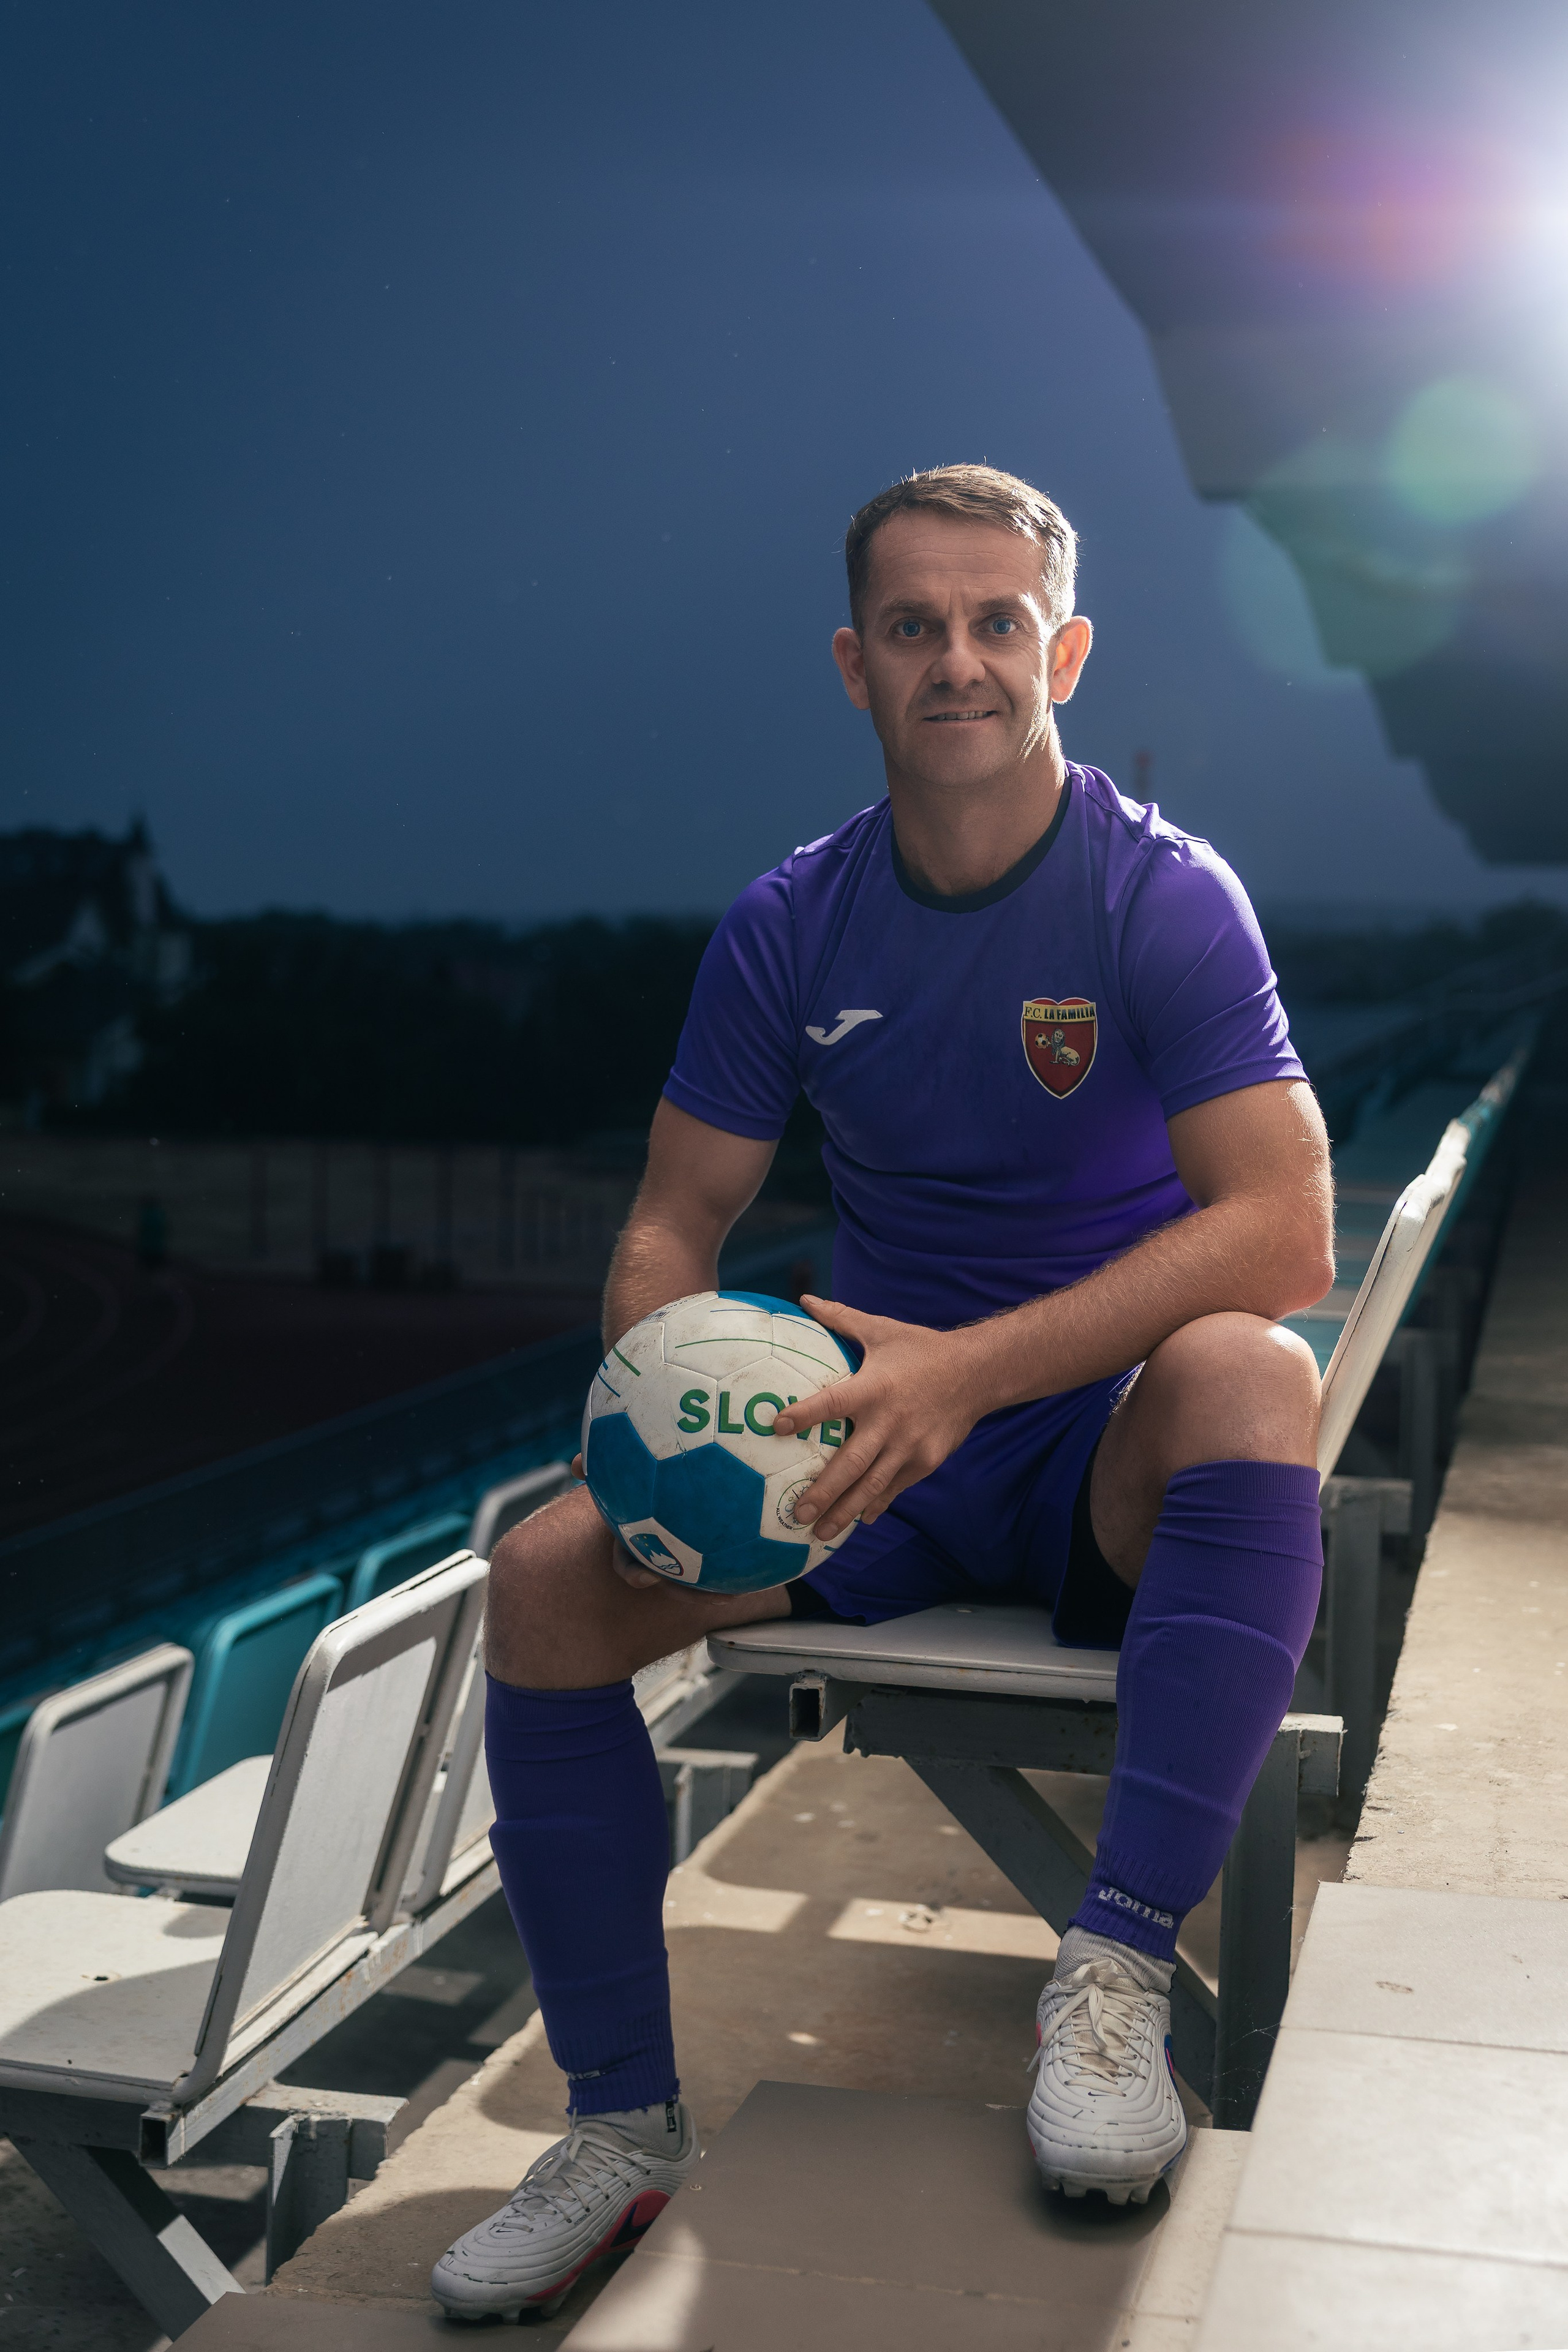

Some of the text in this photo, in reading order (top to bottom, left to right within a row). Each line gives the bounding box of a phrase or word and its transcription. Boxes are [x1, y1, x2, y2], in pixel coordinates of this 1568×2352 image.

[1024, 1006, 1095, 1020] F.C. LA FAMILIA
[777, 1515, 793, 1530] WEATHER
